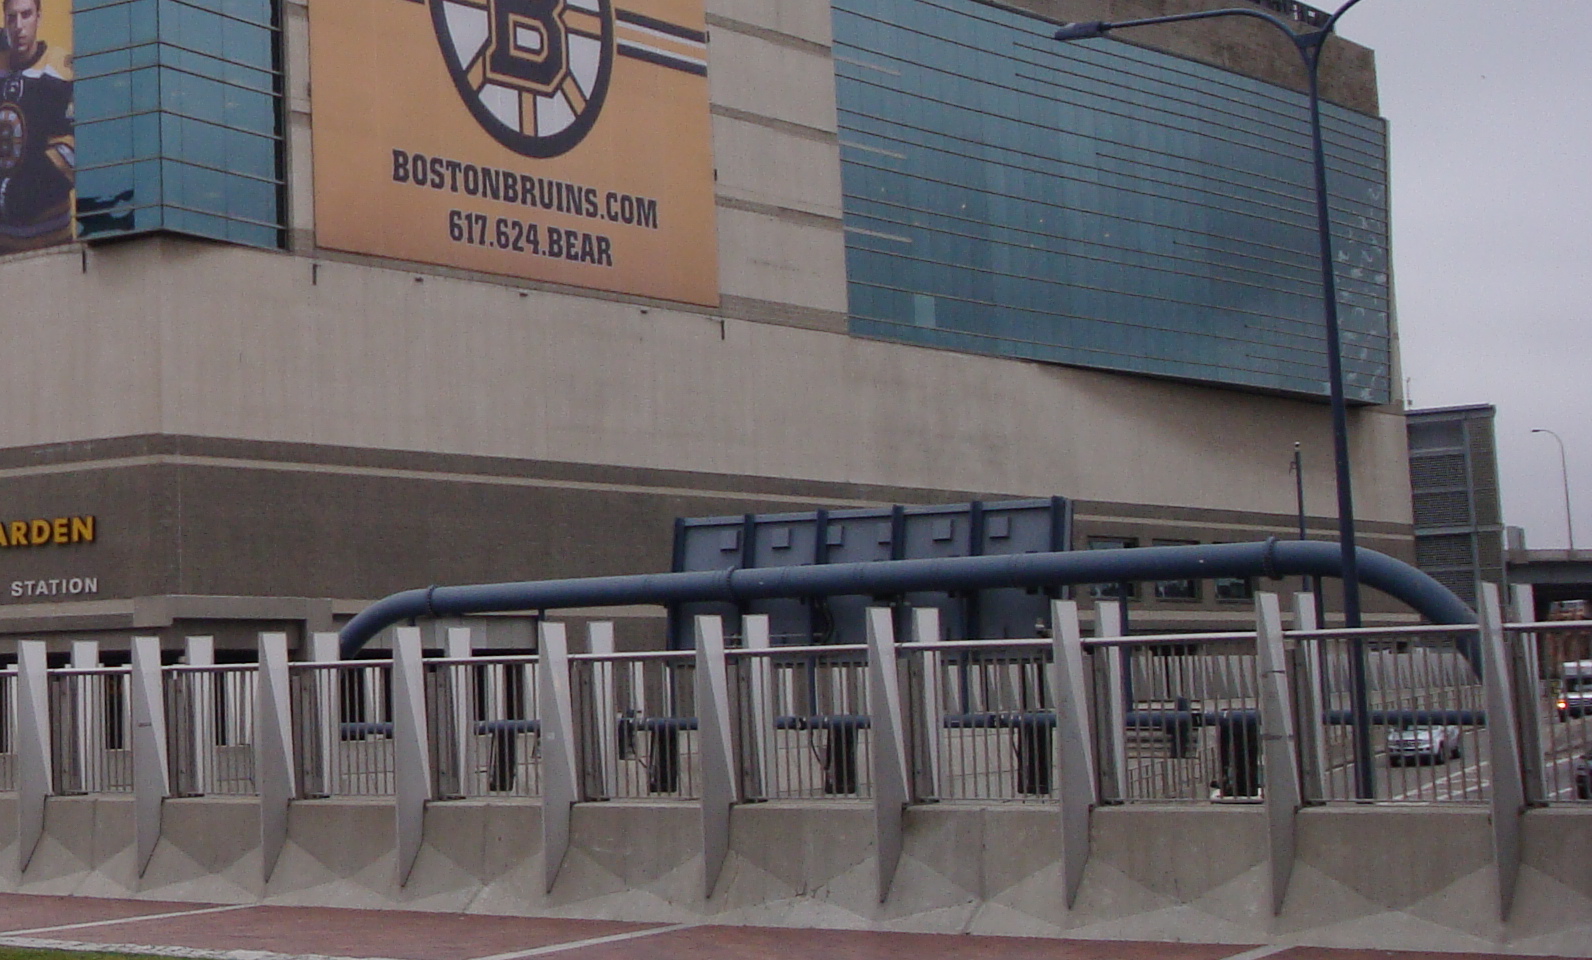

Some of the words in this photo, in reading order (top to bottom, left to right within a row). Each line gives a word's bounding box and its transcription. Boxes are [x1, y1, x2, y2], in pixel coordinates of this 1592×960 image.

[391, 148, 659, 230] BOSTONBRUINS.COM
[448, 209, 613, 267] 617.624.BEAR
[11, 577, 98, 598] STATION
